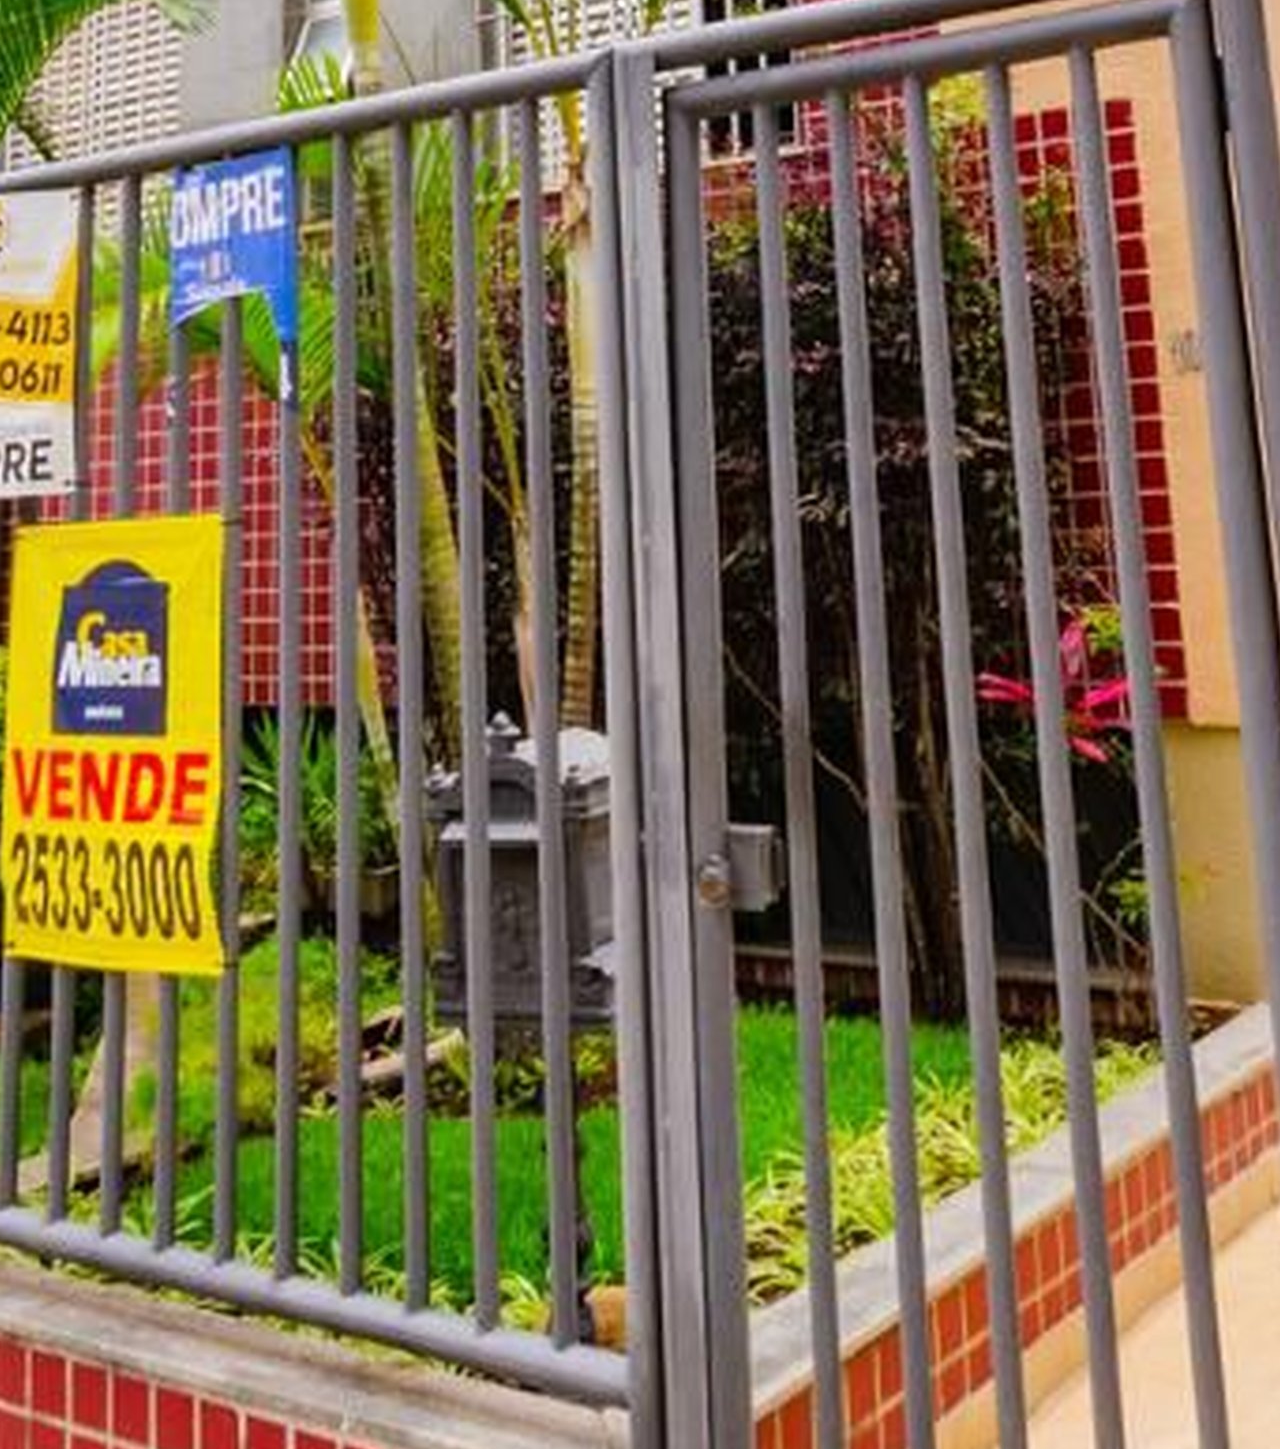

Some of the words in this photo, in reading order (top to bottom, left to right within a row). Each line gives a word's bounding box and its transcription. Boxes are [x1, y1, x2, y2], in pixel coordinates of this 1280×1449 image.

[77, 611, 148, 661] Casa
[12, 749, 208, 825] VENDE
[12, 831, 201, 940] 2533-3000
